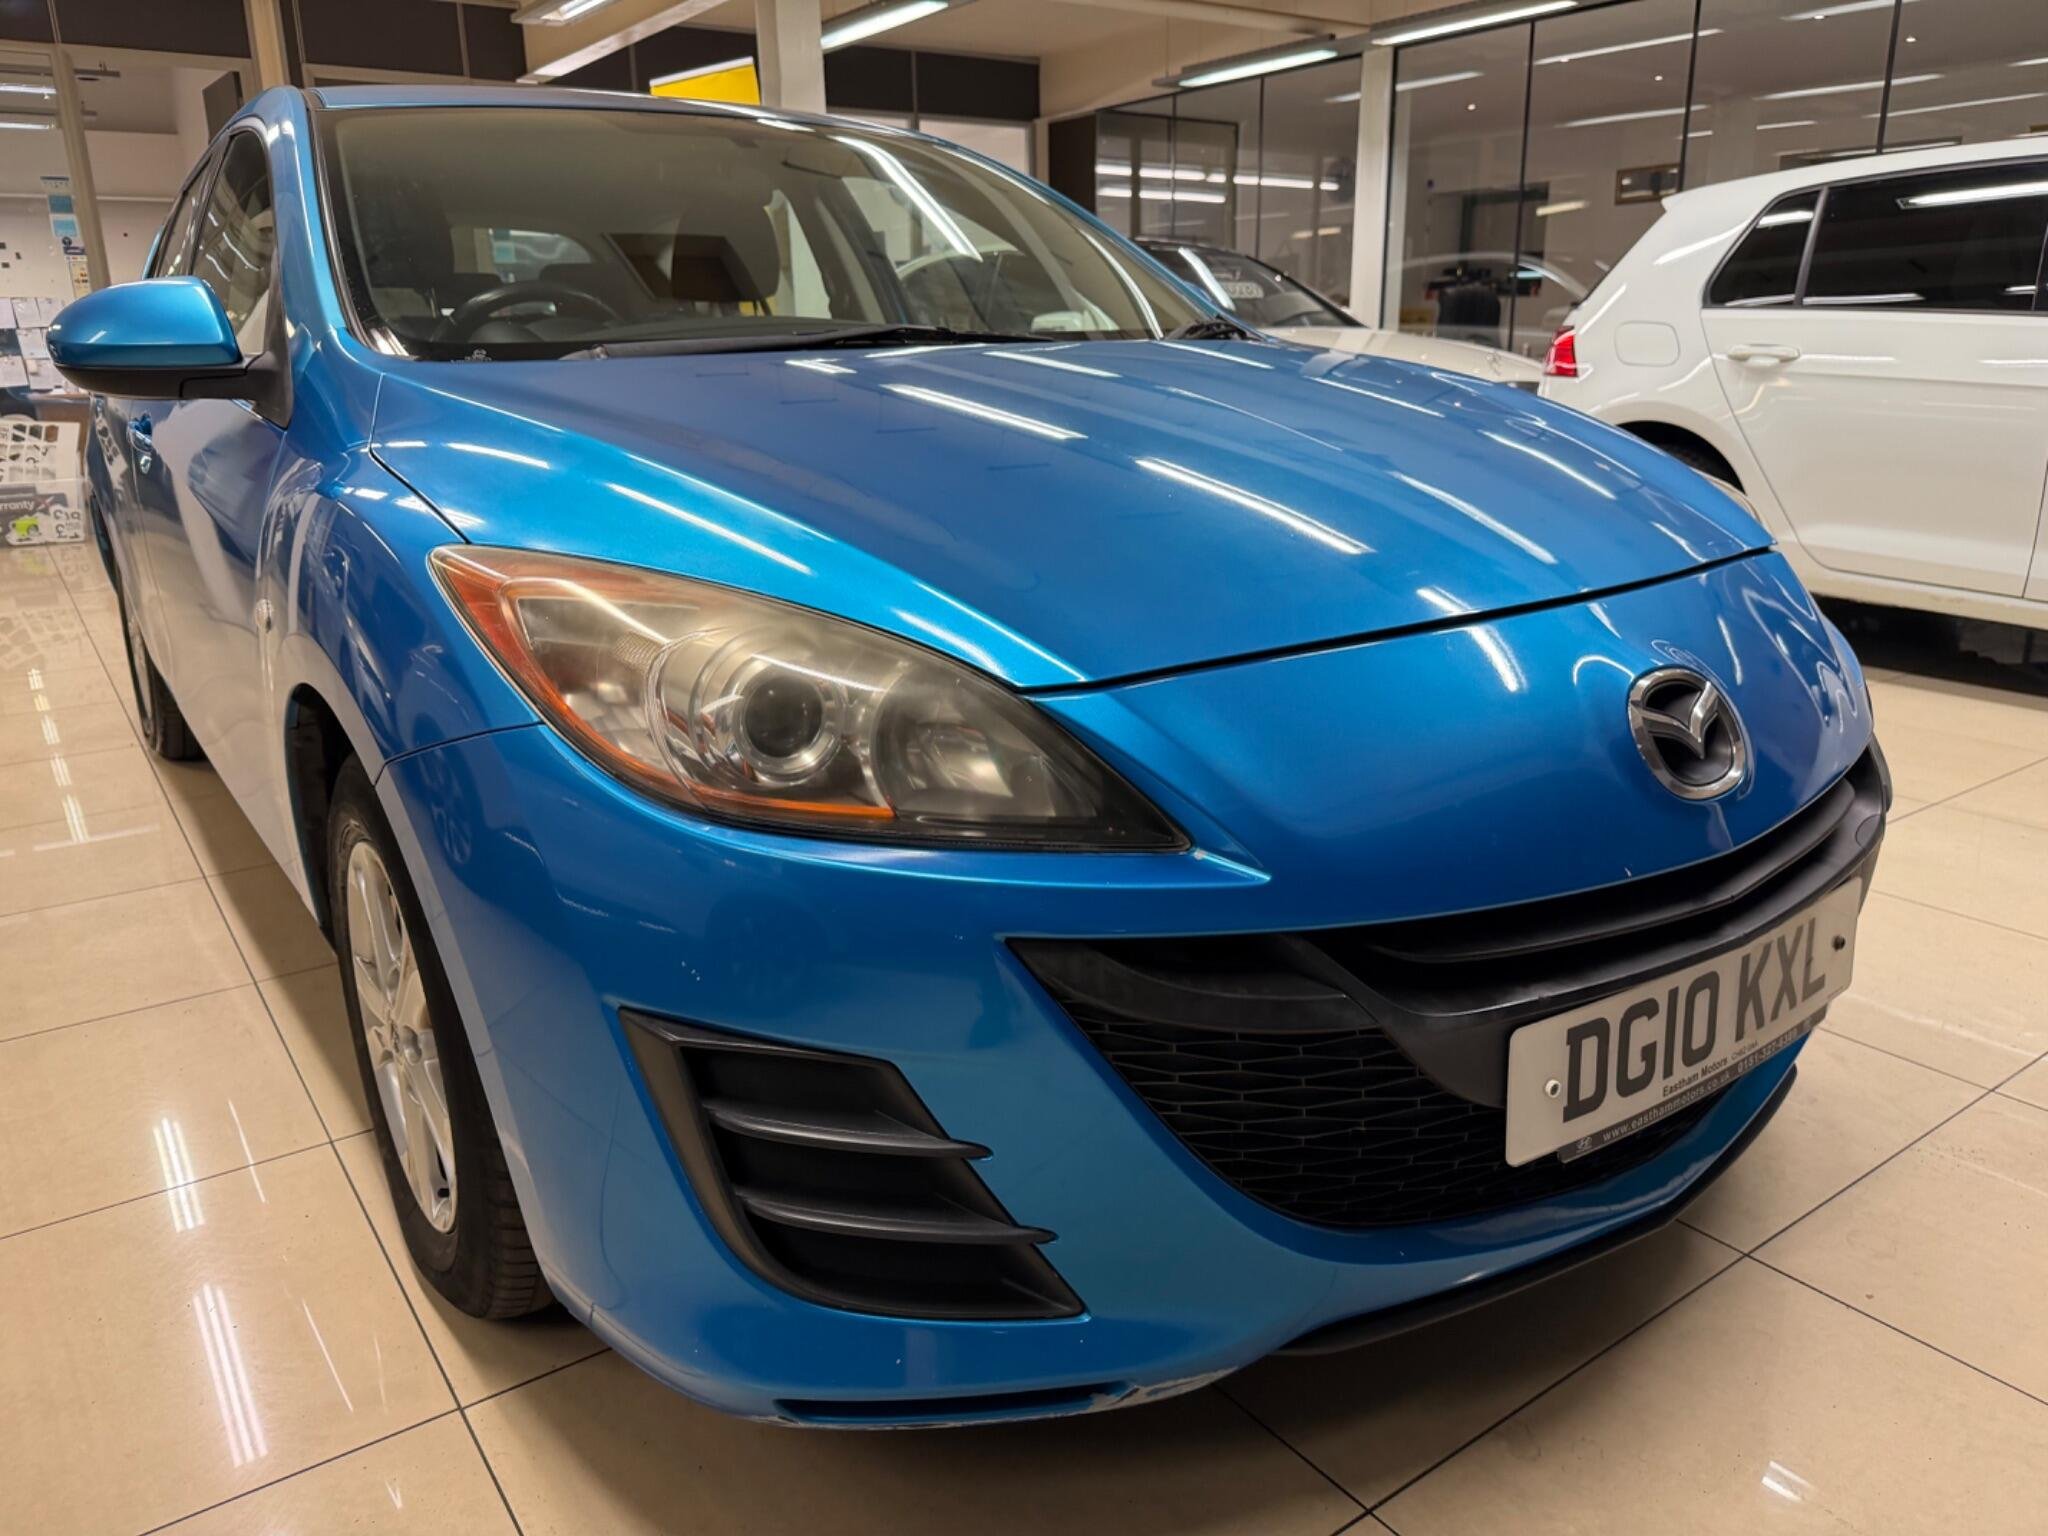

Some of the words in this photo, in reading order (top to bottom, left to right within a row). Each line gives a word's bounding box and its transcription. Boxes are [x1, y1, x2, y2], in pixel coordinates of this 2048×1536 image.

[1563, 970, 1720, 1123] DG10
[1735, 917, 1827, 1042] KXL
[1602, 1072, 1730, 1142] www.easthammotors.co.uk
[1663, 1073, 1699, 1097] Eastham
[1701, 1057, 1728, 1075] Motors
